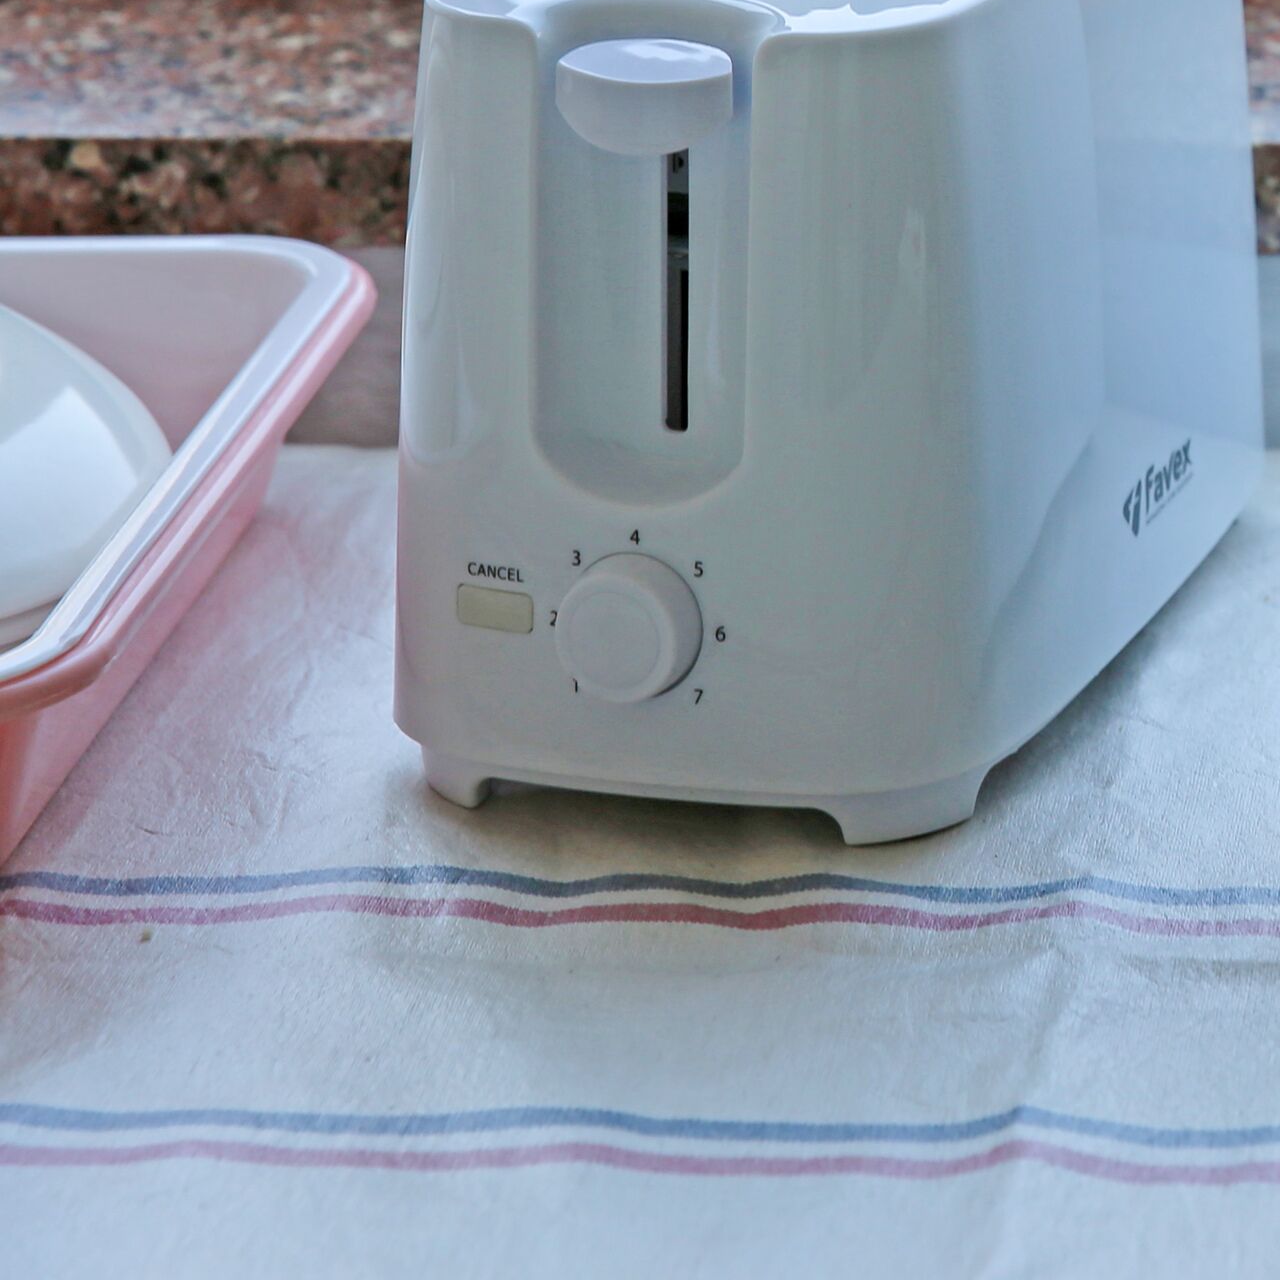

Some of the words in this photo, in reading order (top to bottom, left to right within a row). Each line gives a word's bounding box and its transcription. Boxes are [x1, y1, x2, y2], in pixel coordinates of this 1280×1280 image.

[1145, 438, 1192, 515] Favex
[629, 529, 641, 546] 4
[571, 550, 582, 567] 3
[467, 561, 525, 583] CANCEL
[693, 561, 704, 578] 5
[549, 610, 559, 627] 2
[714, 625, 727, 643] 6
[572, 678, 579, 693] 1
[693, 689, 704, 705] 7
